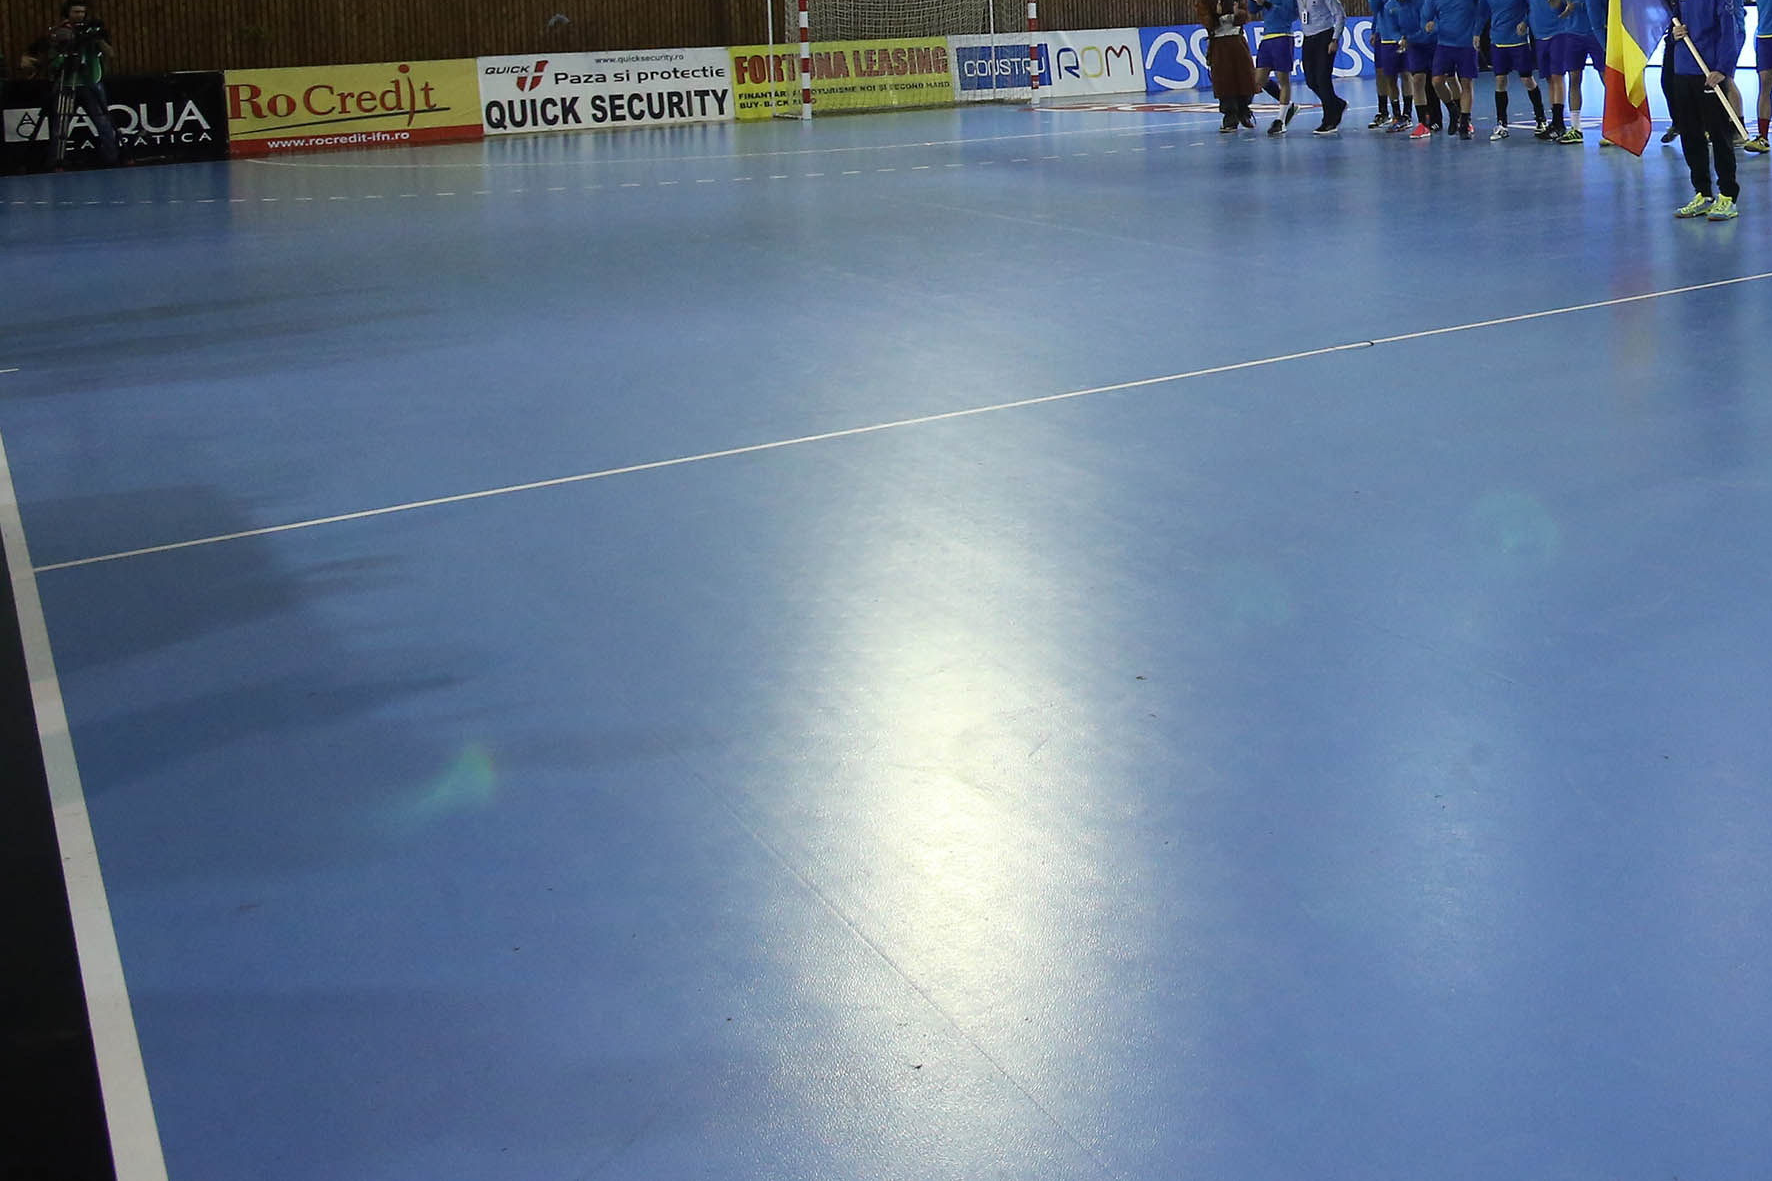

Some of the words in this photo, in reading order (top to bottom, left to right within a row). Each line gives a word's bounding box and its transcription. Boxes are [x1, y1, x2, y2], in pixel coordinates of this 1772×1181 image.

[594, 53, 684, 64] www.quicksecurity.ro
[853, 46, 949, 77] LEASING
[484, 65, 531, 75] QUICK
[554, 71, 607, 85] Paza
[613, 69, 631, 82] si
[637, 65, 725, 83] protectie
[738, 90, 790, 100] FINANTAR
[485, 96, 582, 131] QUICK
[591, 88, 729, 123] SECURITY
[267, 130, 410, 149] www.rocredit-ifn.ro
